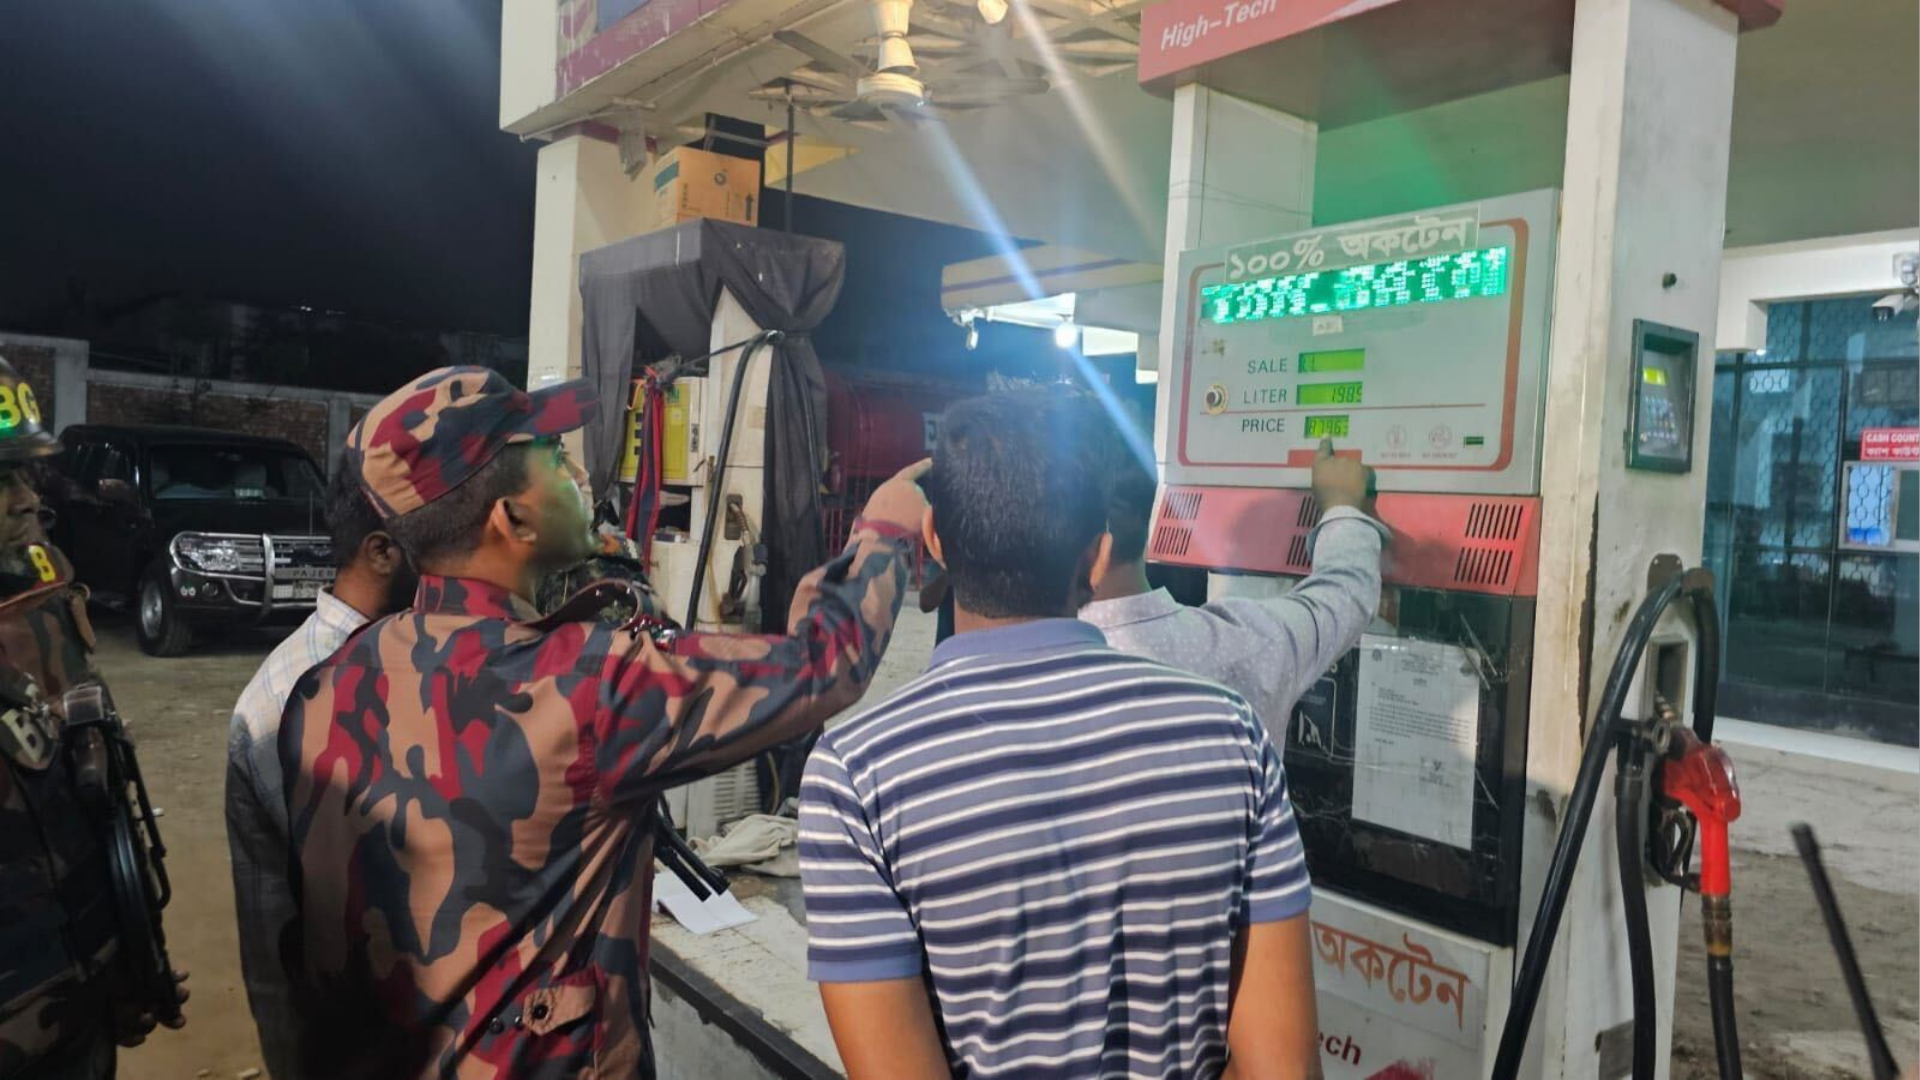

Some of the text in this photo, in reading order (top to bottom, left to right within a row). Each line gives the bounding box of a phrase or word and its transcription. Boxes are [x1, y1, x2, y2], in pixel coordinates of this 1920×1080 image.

[1160, 0, 1277, 51] High-Tech
[1229, 233, 1326, 280] ১০০%
[1335, 215, 1475, 260] অকটেন
[1247, 357, 1288, 375] SALE
[1243, 388, 1287, 404] LITER
[1241, 418, 1286, 433] PRICE
[1310, 921, 1471, 1031] অকটেন
[1319, 1031, 1363, 1066] ch
